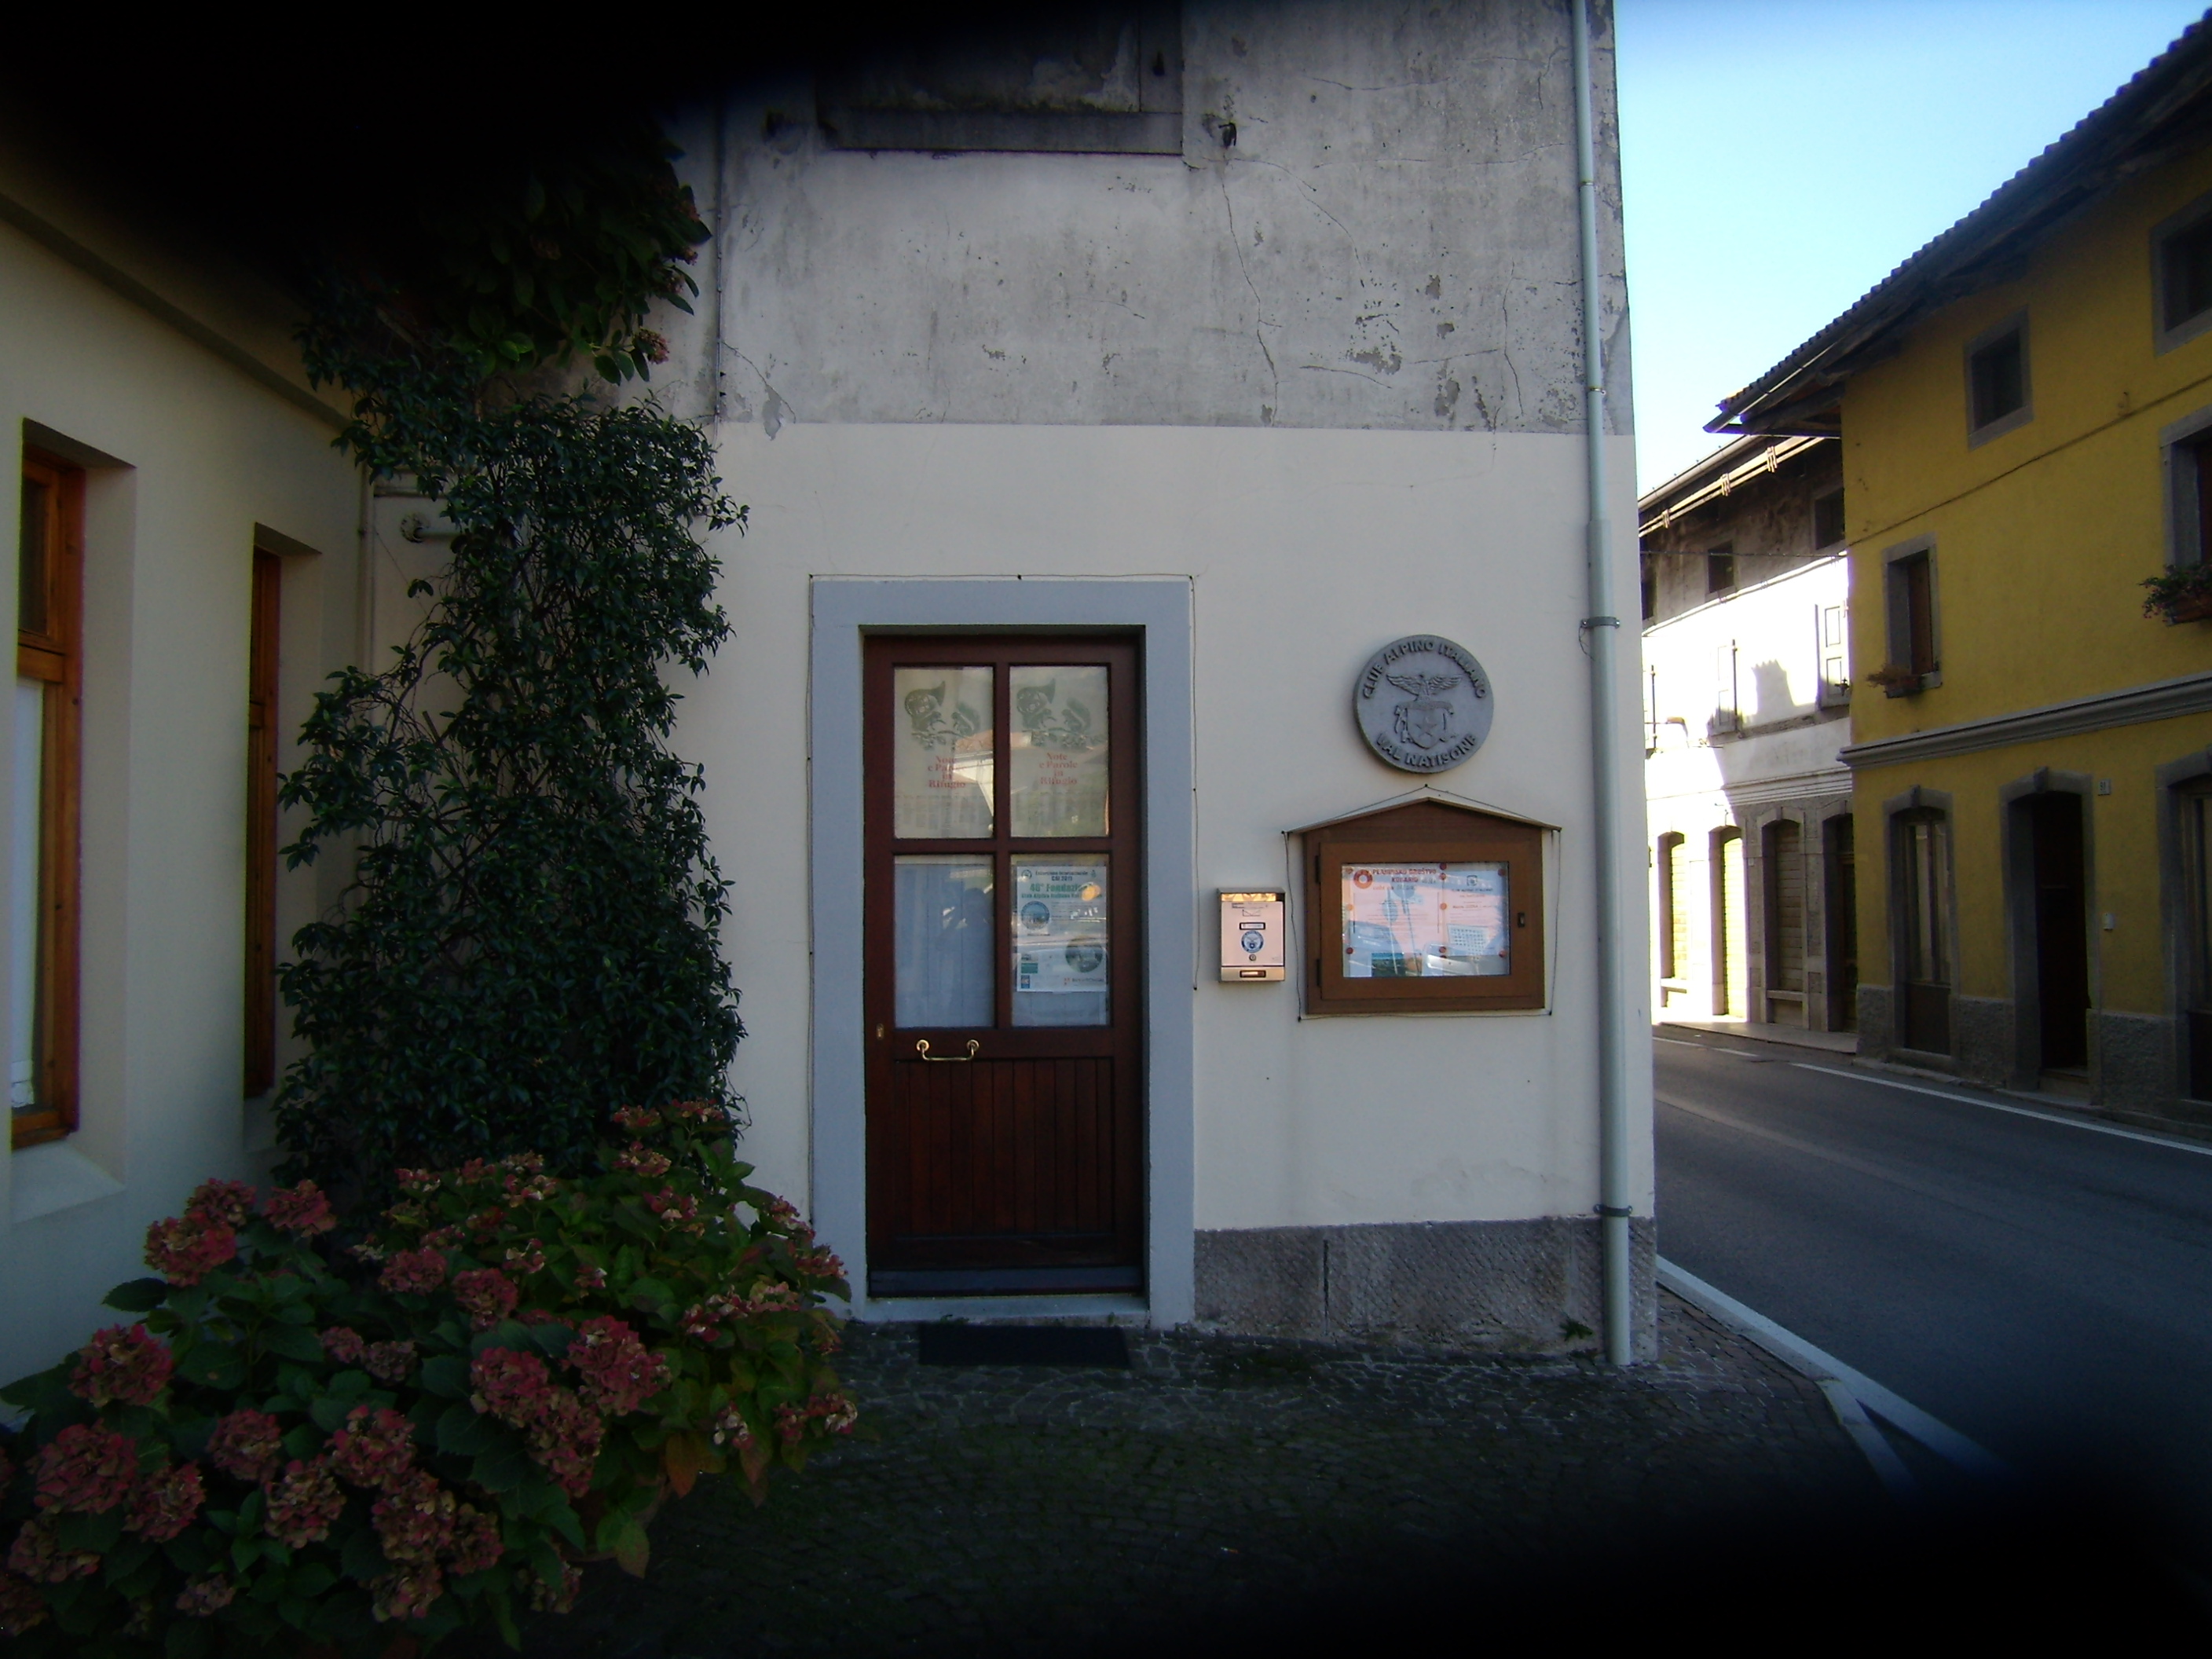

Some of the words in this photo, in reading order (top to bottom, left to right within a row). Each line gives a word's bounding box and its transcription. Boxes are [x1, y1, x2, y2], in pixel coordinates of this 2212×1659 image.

[1362, 663, 1384, 700] CLUB
[1383, 640, 1434, 665] ALPINO
[1437, 643, 1487, 699] ITALIANO
[1375, 732, 1401, 760] VAL
[1405, 732, 1477, 768] NATISONE
[1046, 752, 1068, 760] Note
[1046, 760, 1078, 769] Parole
[928, 779, 966, 789] Rifugio
[1040, 776, 1078, 786] Rifugio
